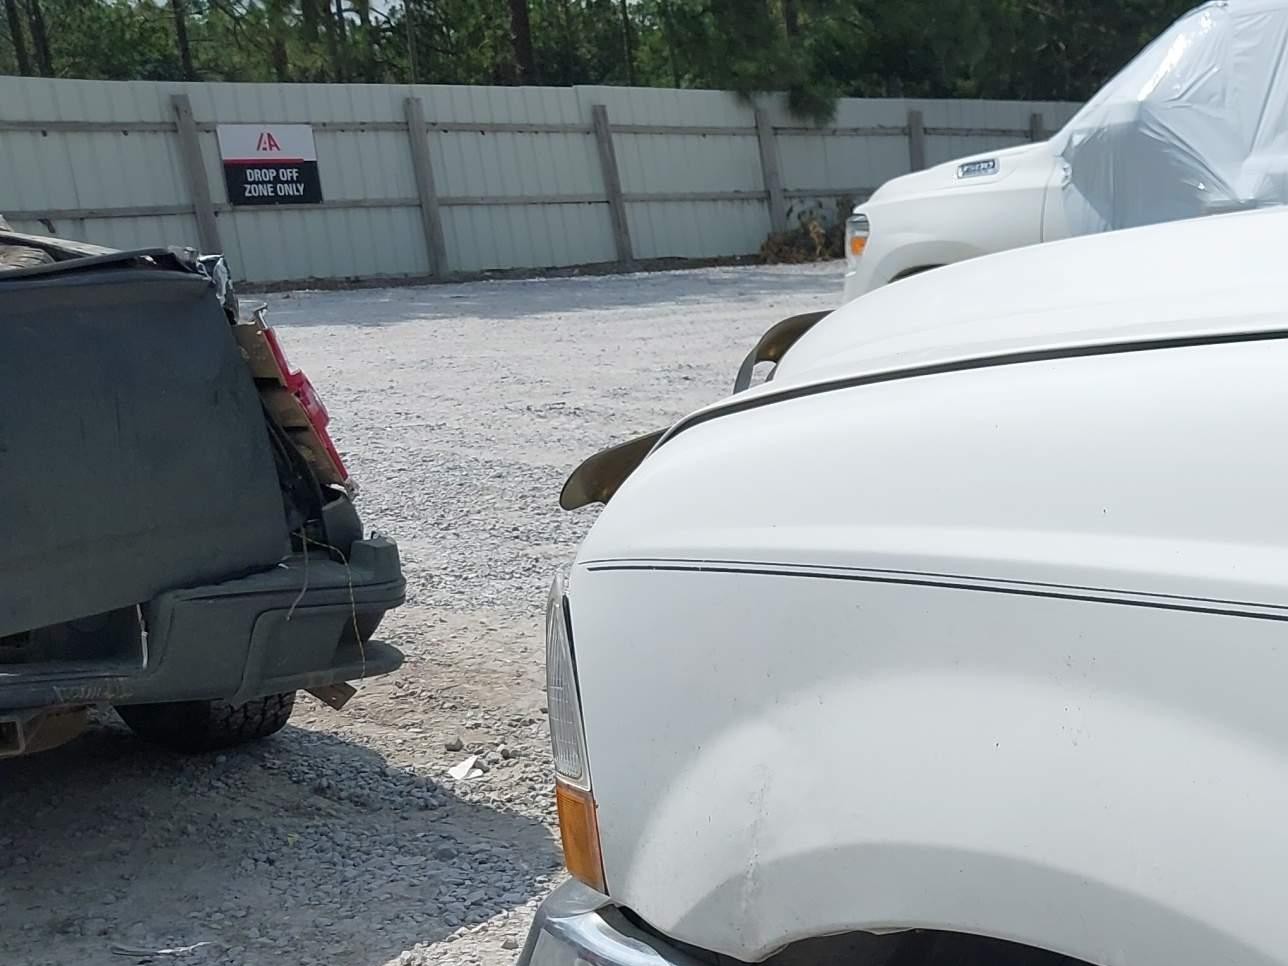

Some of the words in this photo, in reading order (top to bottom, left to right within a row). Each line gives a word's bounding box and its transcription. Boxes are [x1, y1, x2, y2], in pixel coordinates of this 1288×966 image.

[246, 168, 277, 181] DROP
[279, 168, 299, 181] OFF
[244, 183, 275, 197] ZONE
[277, 183, 304, 196] ONLY
